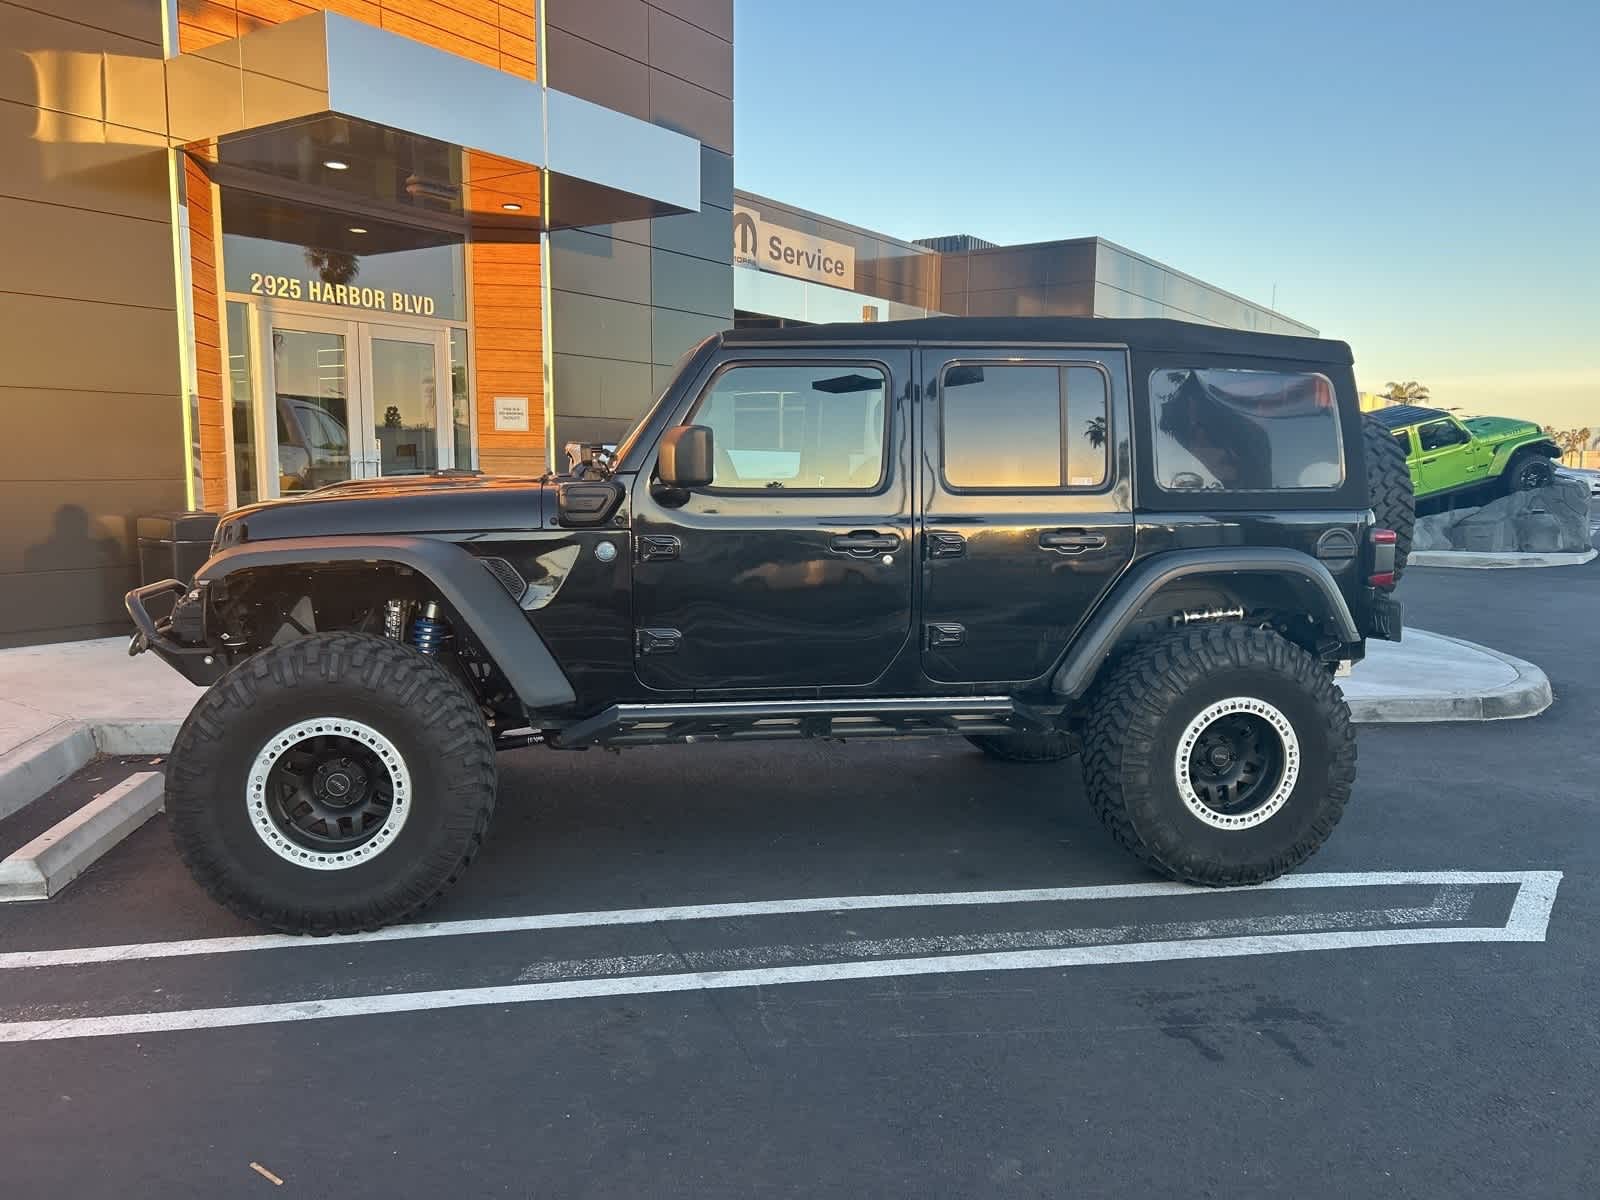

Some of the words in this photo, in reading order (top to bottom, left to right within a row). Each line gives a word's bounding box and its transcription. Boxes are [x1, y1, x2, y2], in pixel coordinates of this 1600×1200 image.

[769, 236, 844, 276] Service
[250, 273, 302, 299] 2925
[309, 280, 385, 309] HARBOR
[392, 292, 434, 315] BLVD
